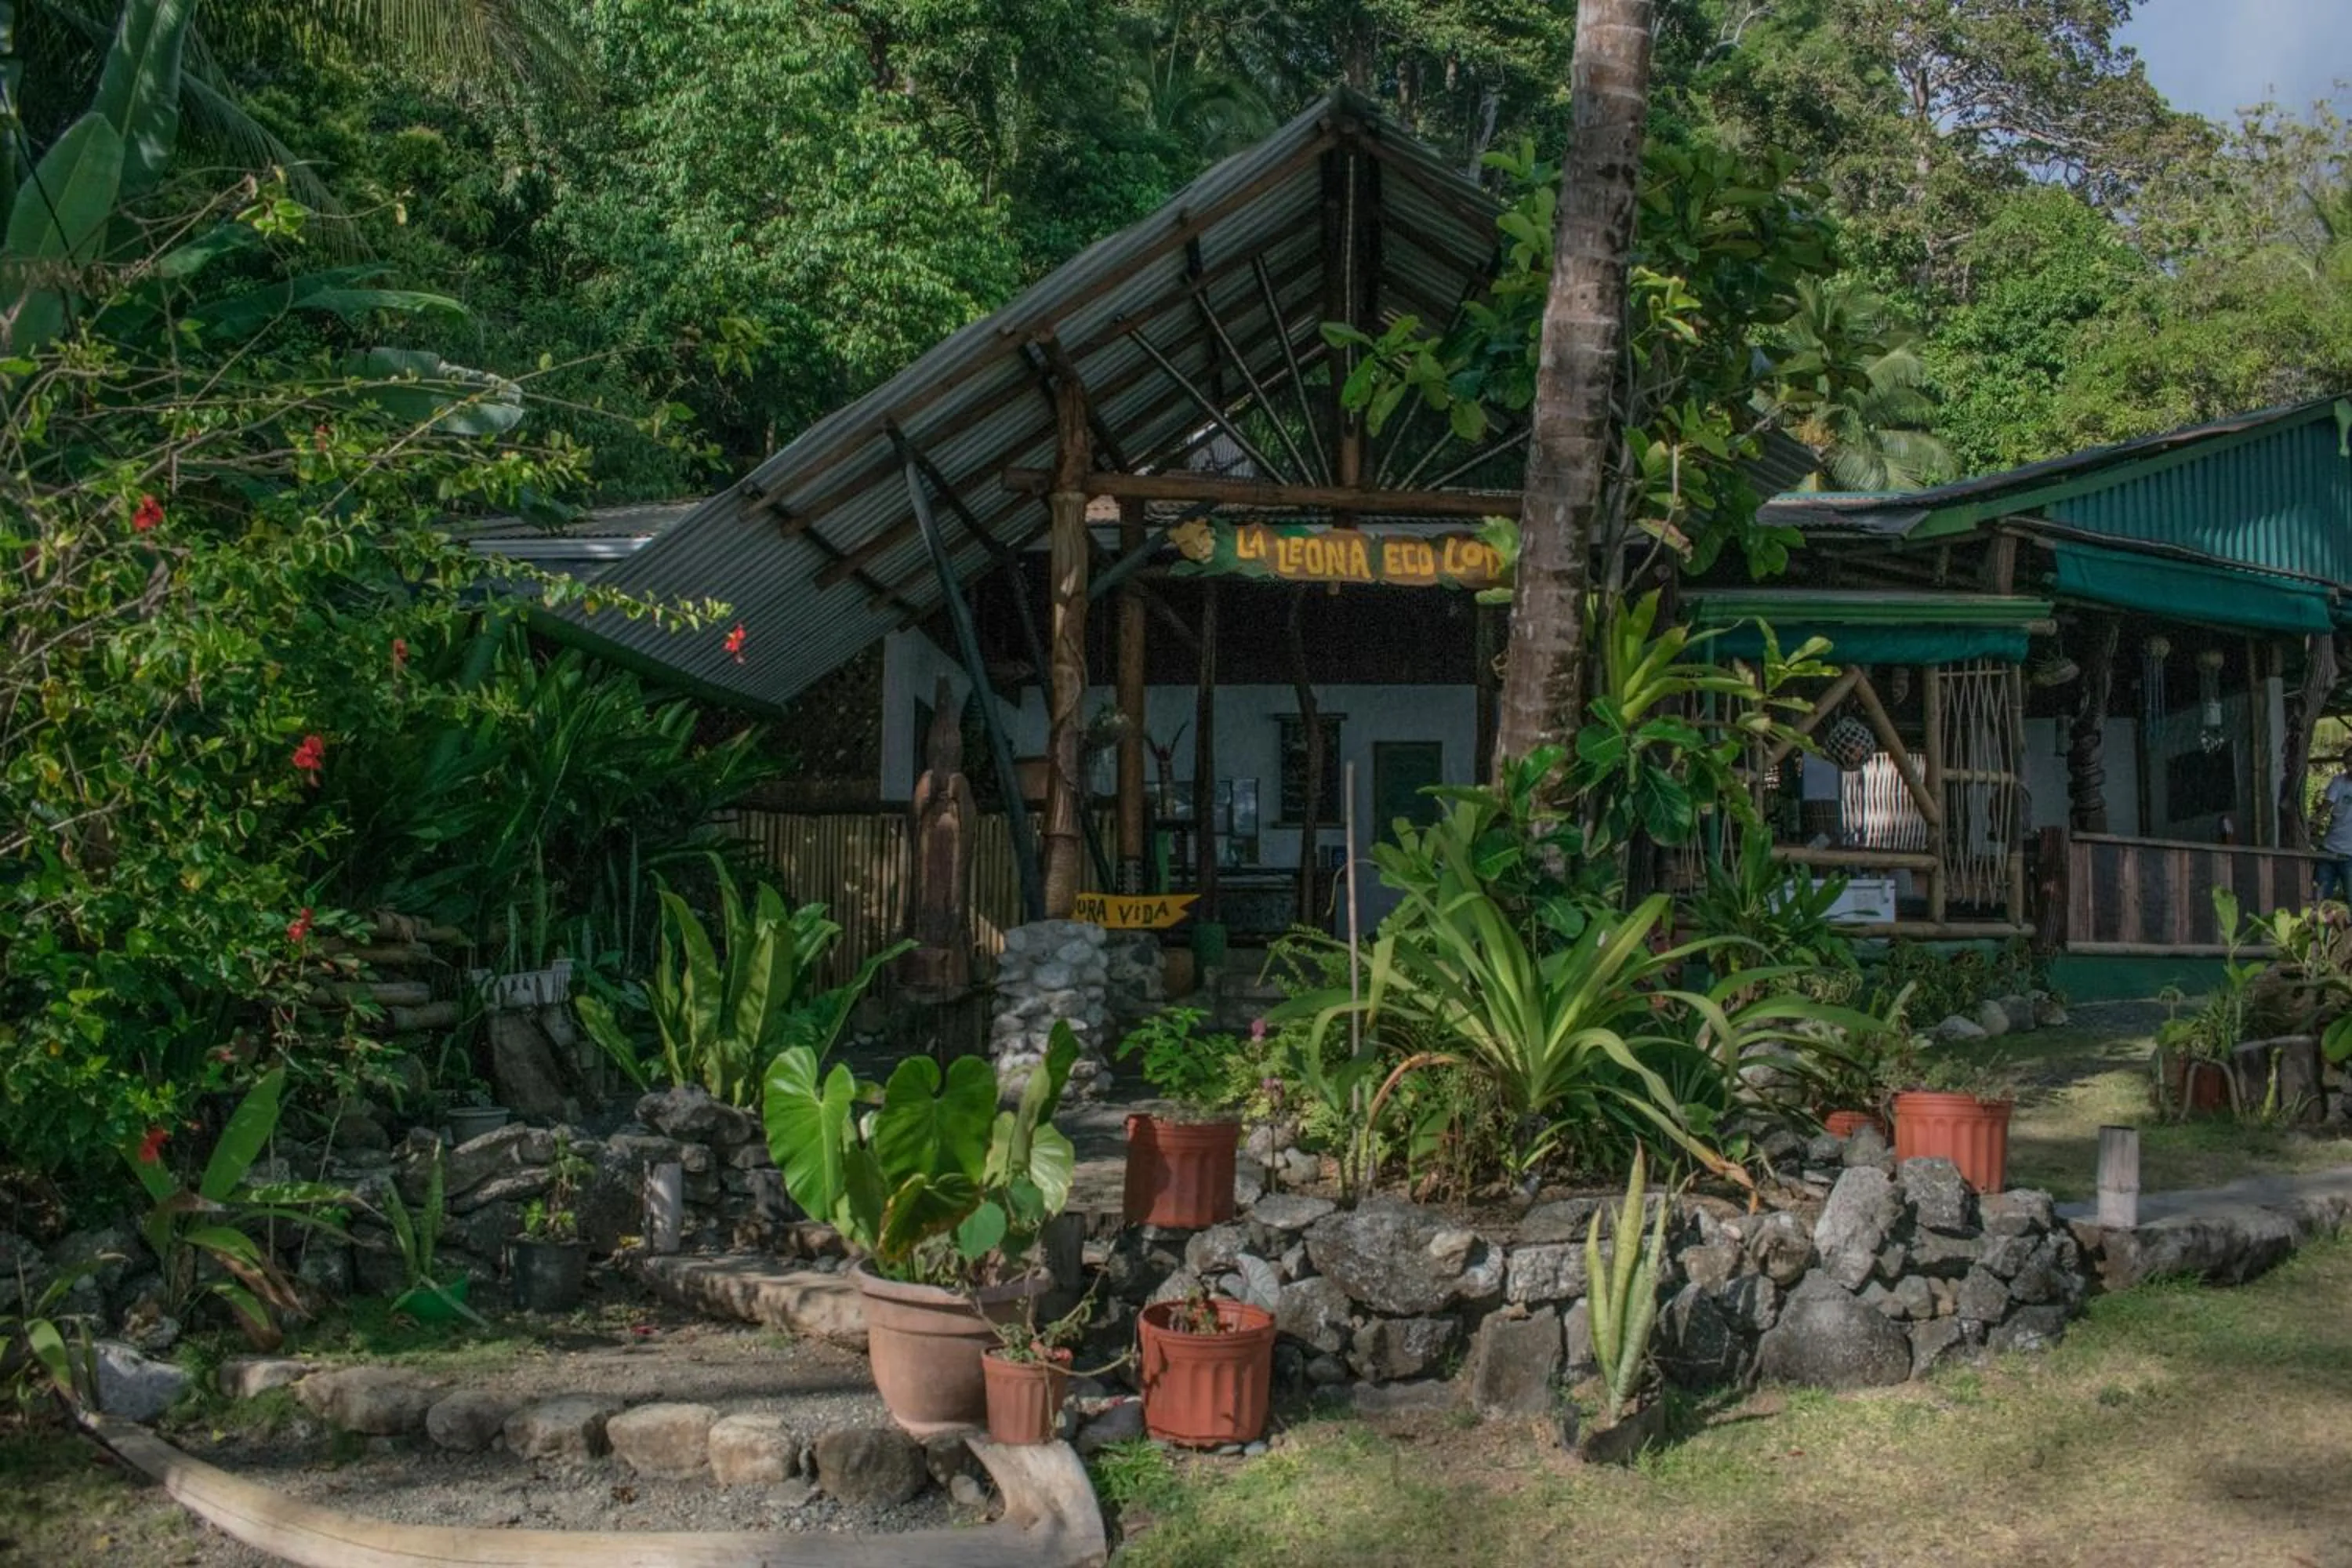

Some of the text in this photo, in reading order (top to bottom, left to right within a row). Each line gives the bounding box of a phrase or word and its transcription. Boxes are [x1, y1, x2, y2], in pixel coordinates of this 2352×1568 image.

[1236, 527, 1504, 579] LA LEONA ECO LOD
[1076, 898, 1108, 924] URA
